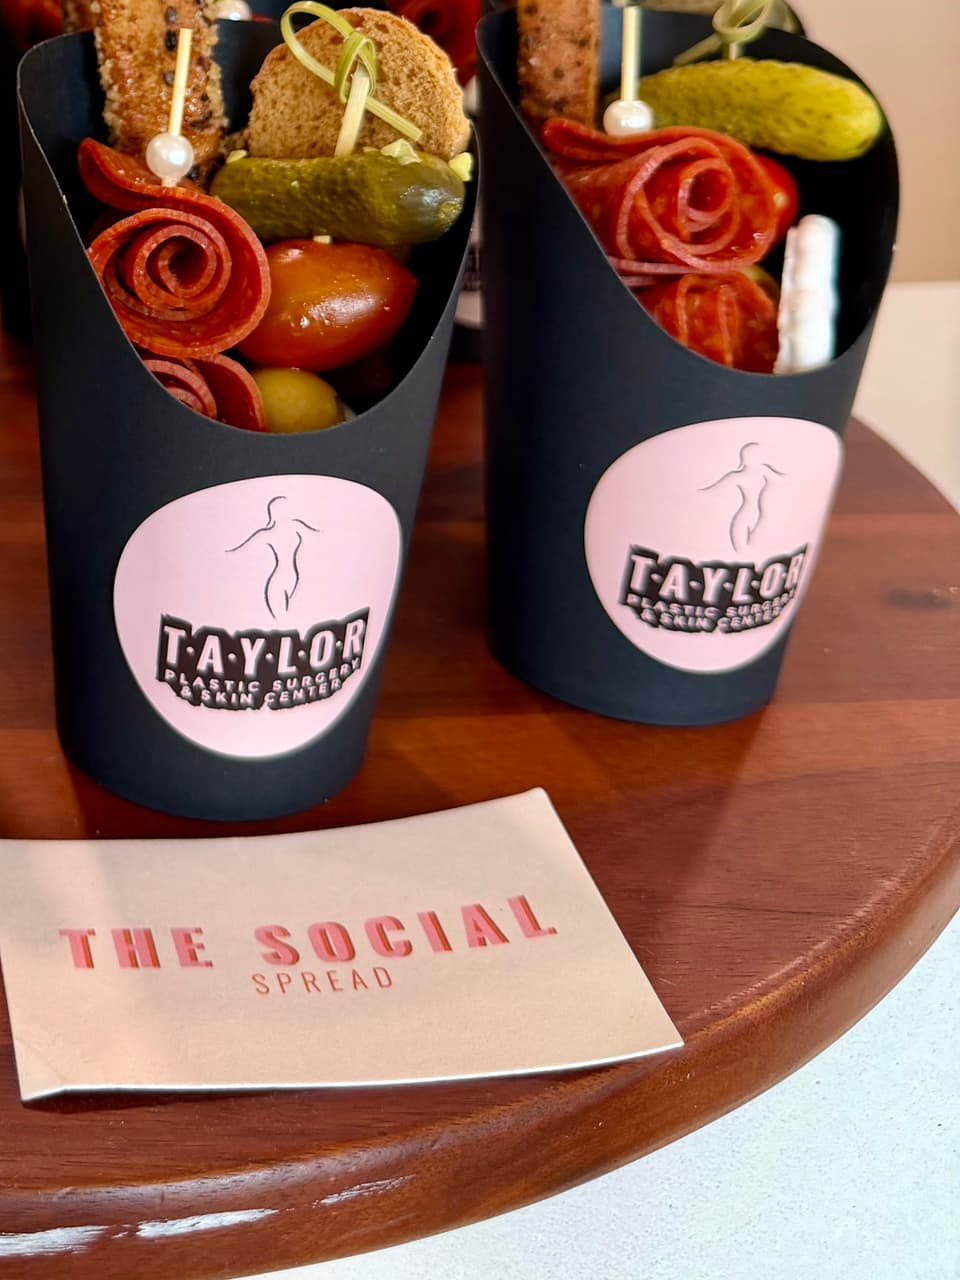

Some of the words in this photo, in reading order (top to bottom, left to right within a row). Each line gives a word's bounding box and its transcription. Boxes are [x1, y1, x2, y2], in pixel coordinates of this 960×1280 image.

[165, 669, 261, 692] PLASTIC
[272, 657, 360, 691] SURGERY
[201, 690, 253, 704] SKIN
[264, 679, 340, 704] CENTER
[58, 927, 213, 968] THE
[253, 894, 558, 966] SOCIAL
[251, 966, 393, 995] SPREAD
